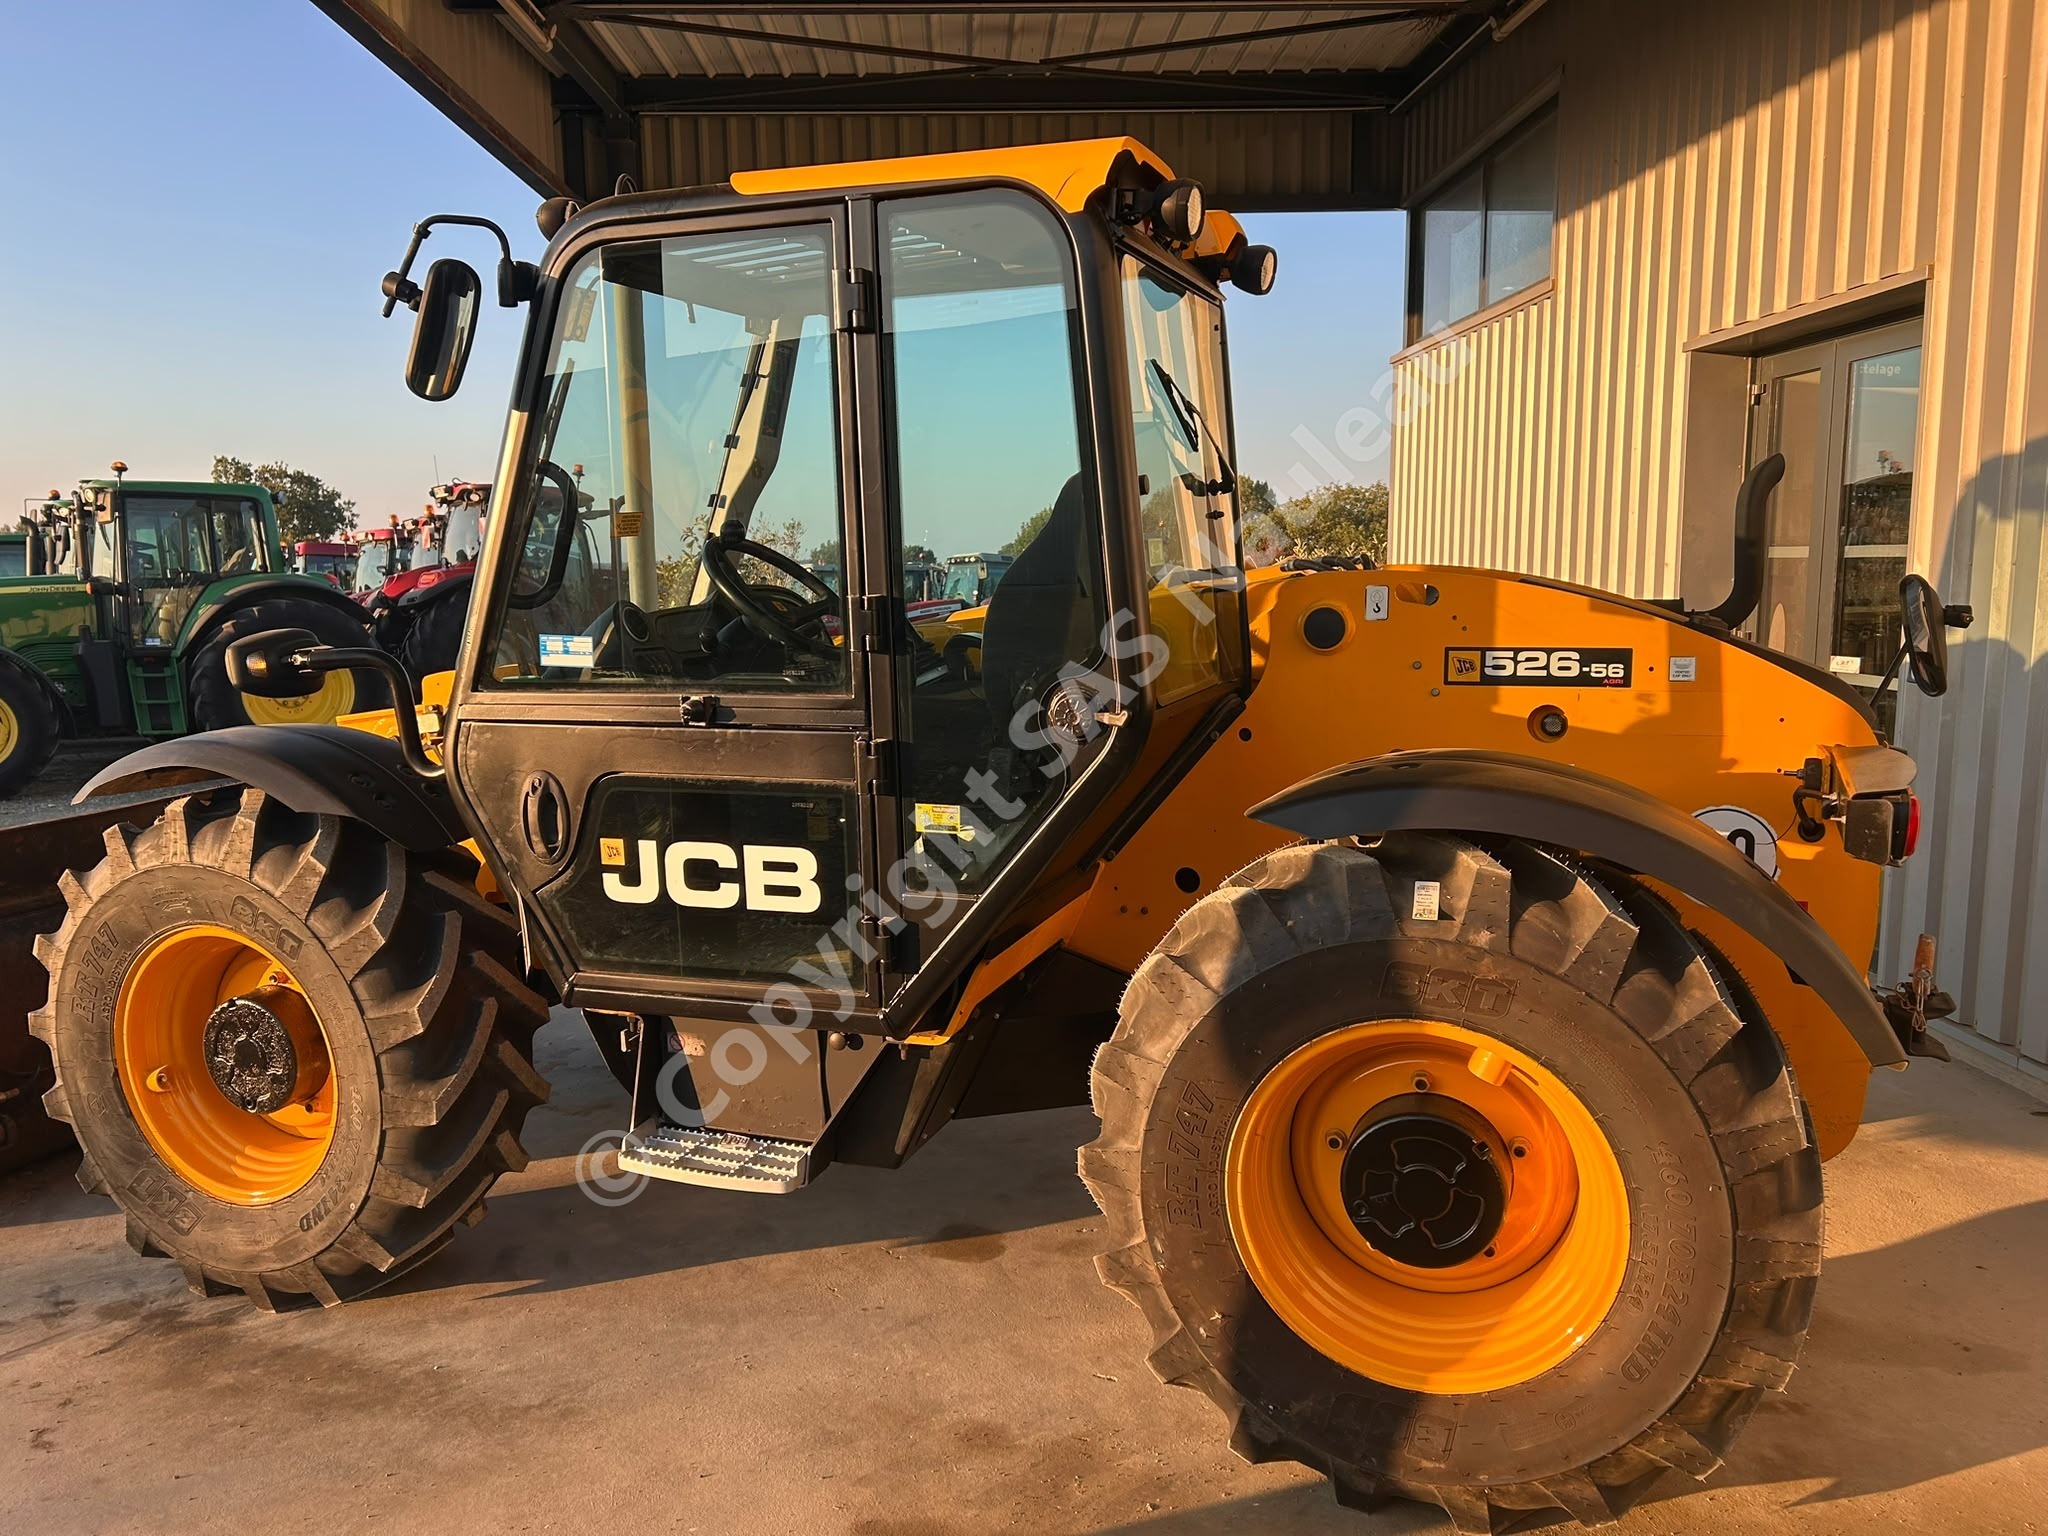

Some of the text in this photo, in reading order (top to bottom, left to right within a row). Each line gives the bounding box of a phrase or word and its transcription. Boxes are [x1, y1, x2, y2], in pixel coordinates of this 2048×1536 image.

[50, 585, 78, 593] DEERE
[1455, 651, 1625, 678] JCB 526-56
[602, 839, 822, 914] JCB
[231, 896, 303, 960] BKT
[71, 921, 119, 1024] RT 747
[1384, 963, 1514, 1017] BKT
[101, 994, 112, 1020] AGRO
[1165, 1080, 1215, 1229] RT 747
